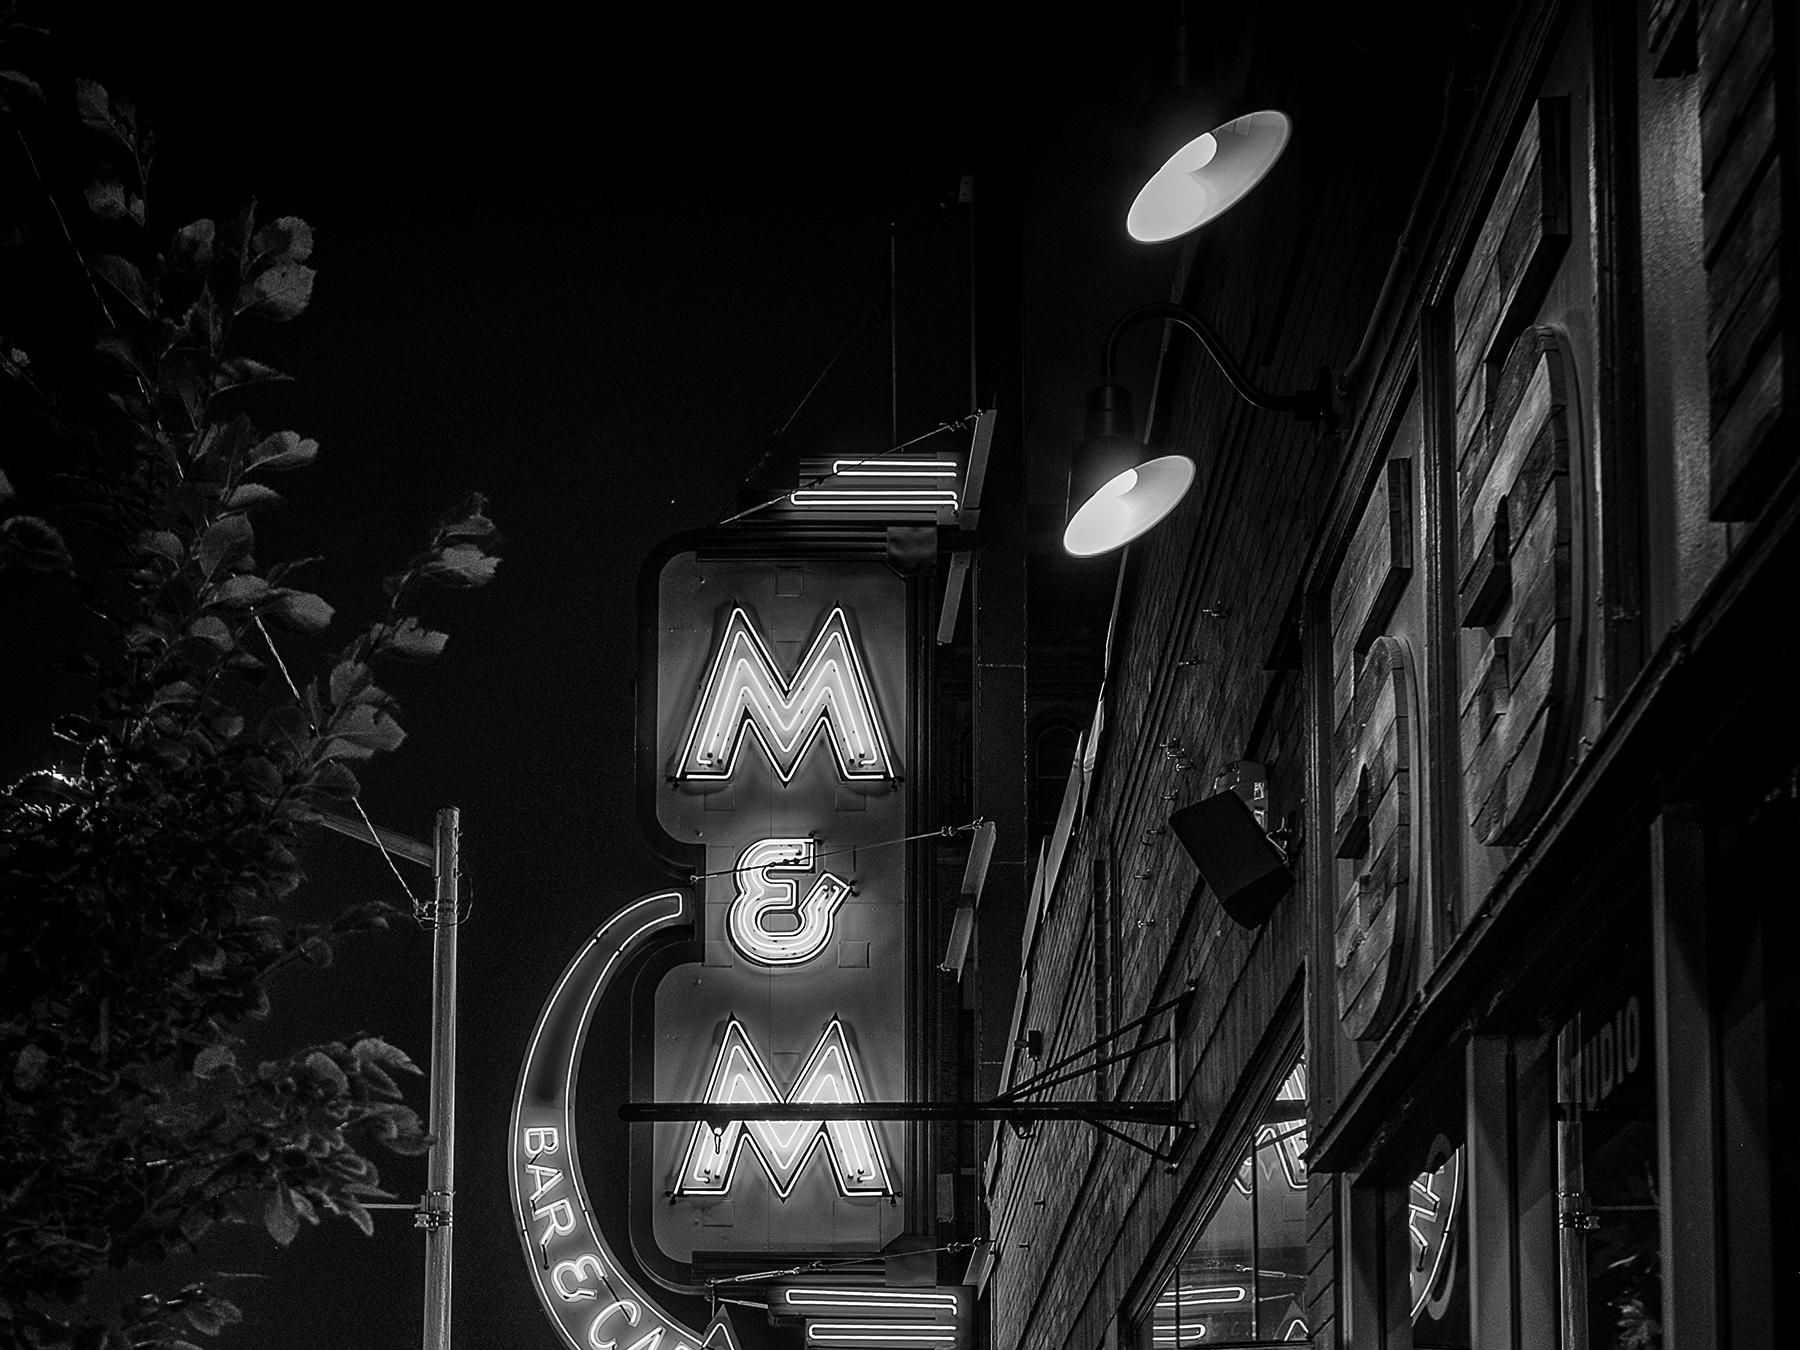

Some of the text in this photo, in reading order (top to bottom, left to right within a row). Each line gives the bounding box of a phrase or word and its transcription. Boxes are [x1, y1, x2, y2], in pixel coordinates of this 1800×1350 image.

[669, 602, 899, 1201] M & M
[523, 1126, 576, 1247] BAR
[550, 1253, 606, 1302] &
